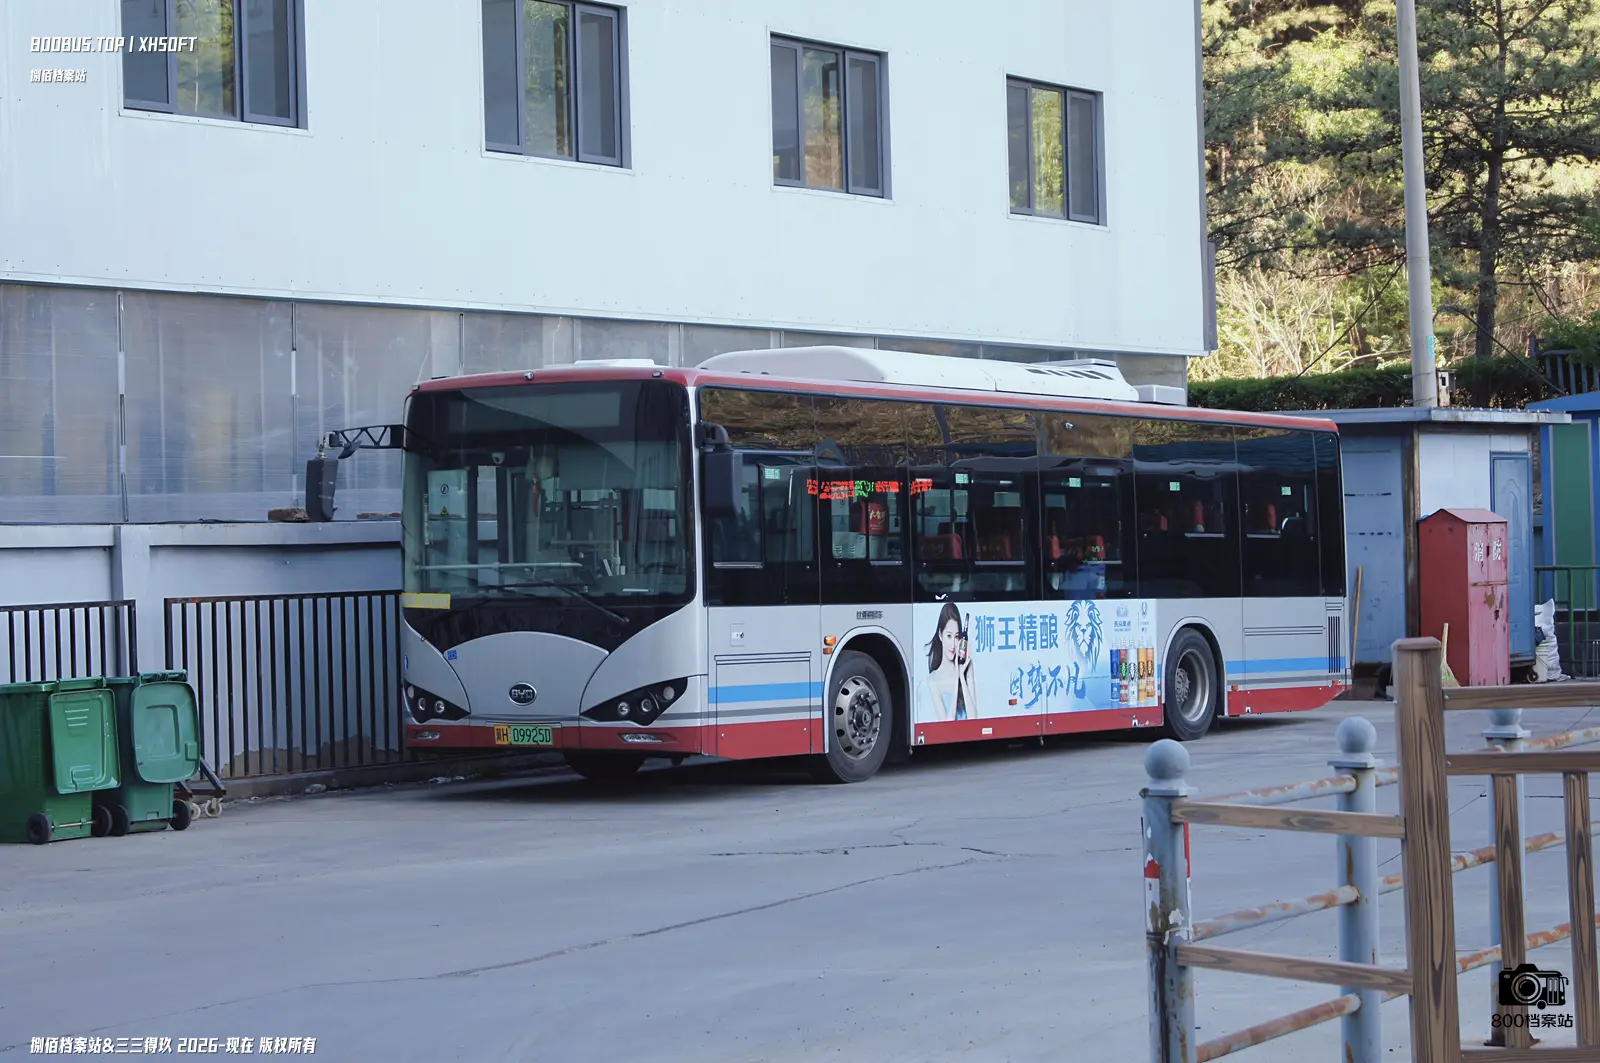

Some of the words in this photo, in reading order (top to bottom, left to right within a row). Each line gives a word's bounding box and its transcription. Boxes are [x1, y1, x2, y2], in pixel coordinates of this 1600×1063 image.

[975, 613, 1059, 653] 狮王精酿
[511, 689, 533, 699] BYD
